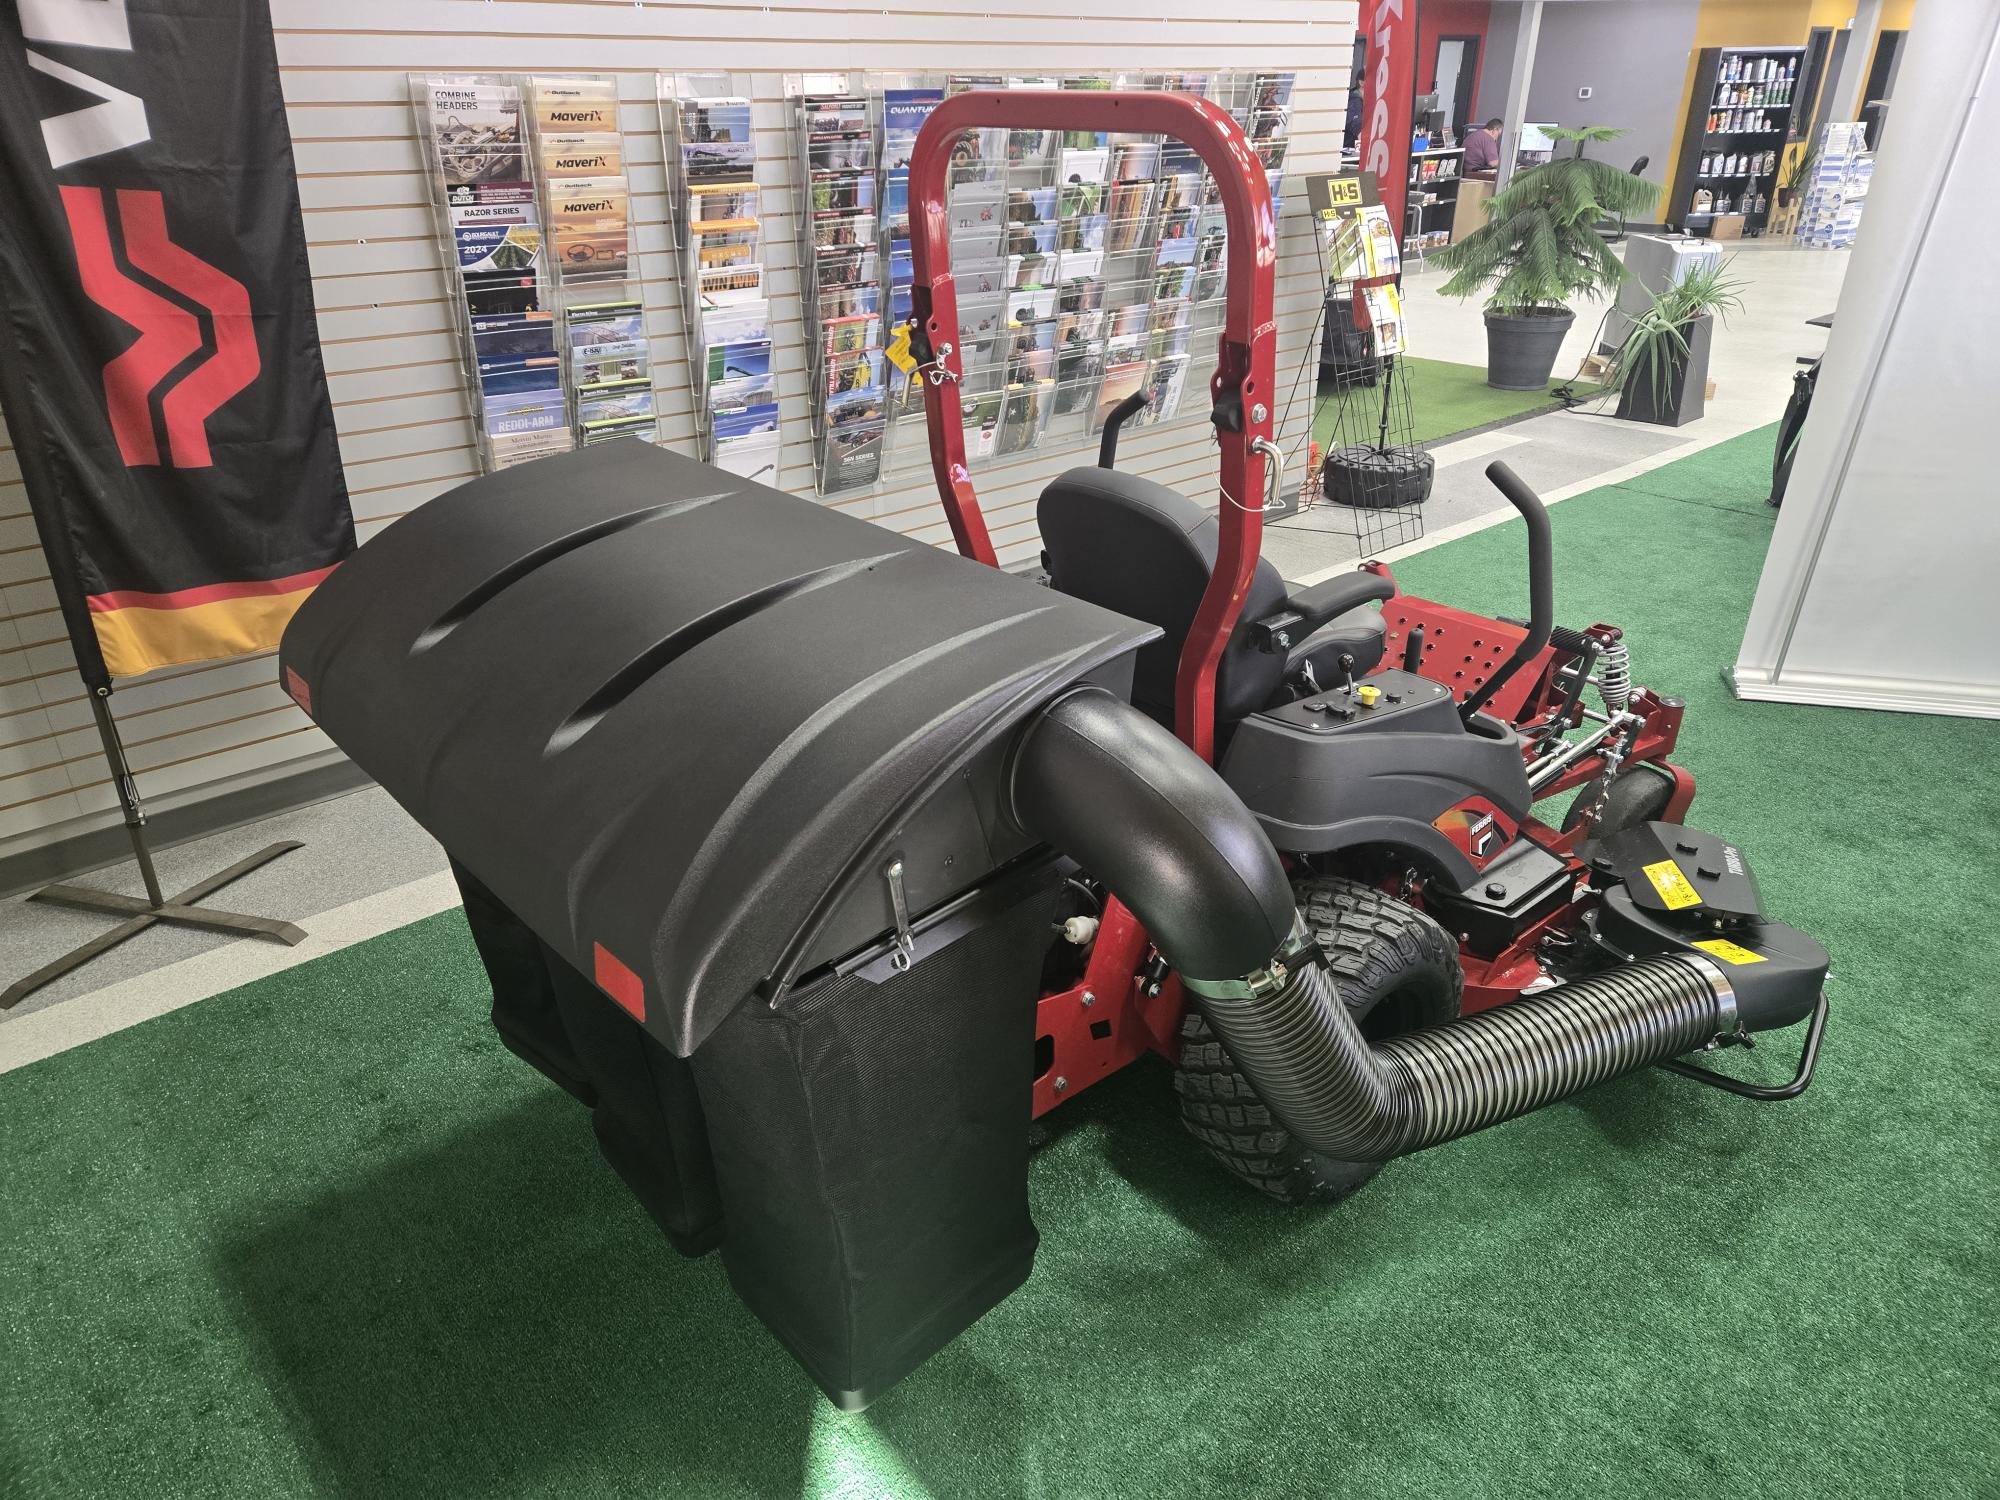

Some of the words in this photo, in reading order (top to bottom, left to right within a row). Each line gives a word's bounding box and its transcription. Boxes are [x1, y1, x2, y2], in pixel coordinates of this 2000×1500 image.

[435, 91, 476, 100] COMBINE
[436, 101, 478, 110] HEADERS
[550, 110, 603, 121] MaveriX
[556, 156, 607, 168] MaveriX
[1332, 183, 1359, 201] H&S
[452, 194, 474, 203] DUTCH
[464, 209, 491, 217] RAZOR
[493, 207, 520, 215] SERIES
[563, 200, 614, 213] MaveriX
[464, 246, 487, 254] 2024
[498, 415, 554, 432] REDDI-ARM
[1472, 814, 1492, 835] FERRIS
